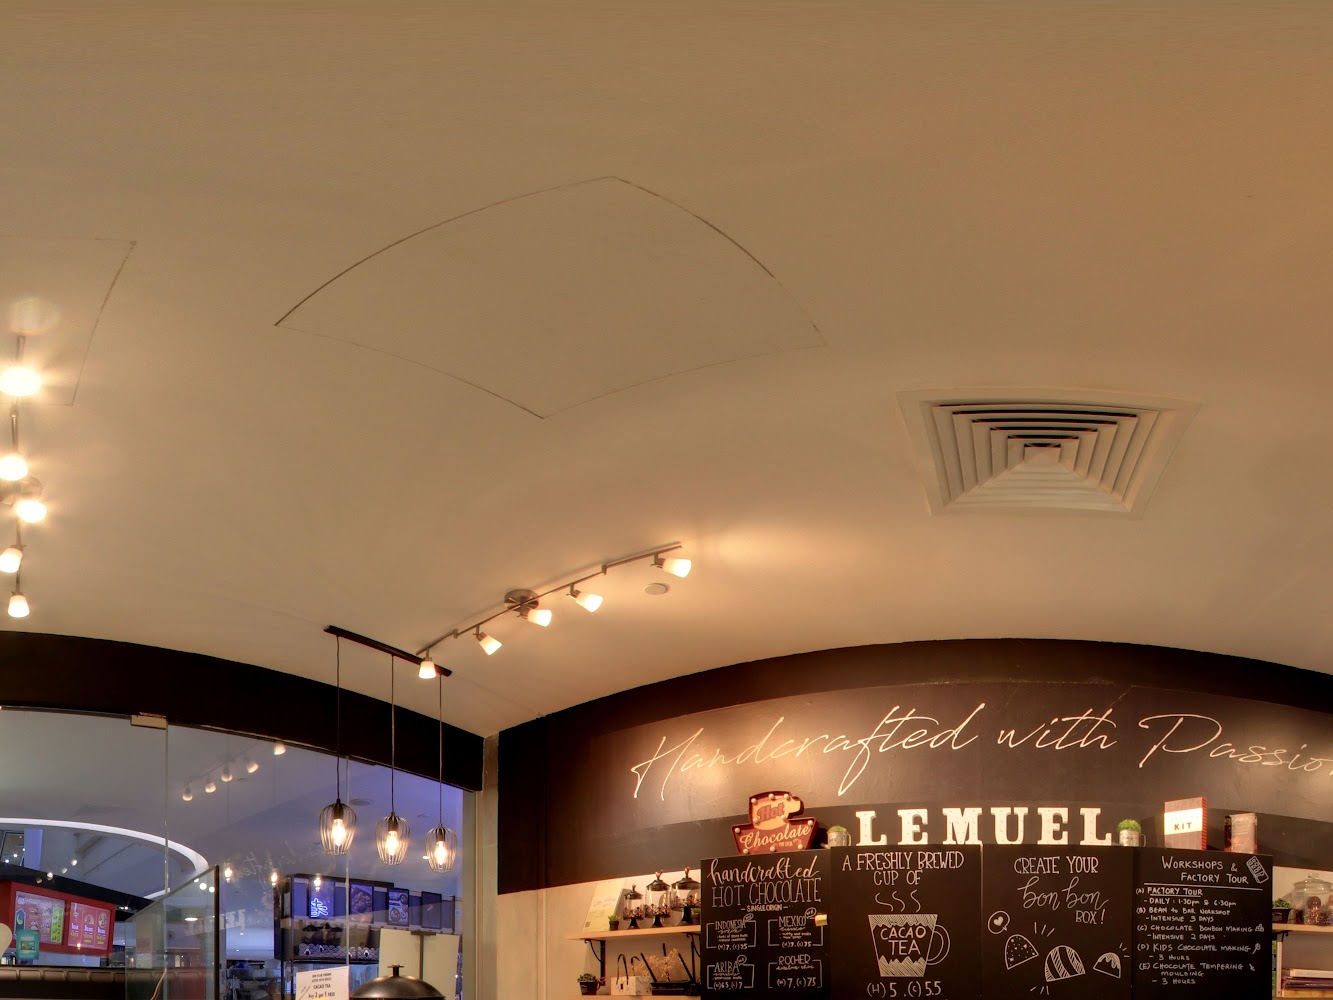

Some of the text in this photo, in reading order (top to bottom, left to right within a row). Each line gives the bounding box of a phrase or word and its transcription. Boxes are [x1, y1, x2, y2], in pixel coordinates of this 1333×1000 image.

[631, 702, 985, 800] Handcrafted
[997, 708, 1117, 750] with
[757, 802, 785, 821] Hot
[855, 807, 1112, 847] LEMUEL
[1174, 822, 1193, 832] KIT
[740, 824, 811, 849] Chocolate
[842, 851, 964, 871] A FRESHLY BREWED
[1013, 856, 1099, 874] CREATE YOUR
[1161, 856, 1238, 872] WORKSHOPS &
[707, 855, 820, 886] handcrafted
[873, 870, 923, 886] CUP OF
[1180, 872, 1249, 884] FACTORY TOUR
[712, 877, 821, 908] HOT CHOCOLATE
[1017, 876, 1109, 910] bon bon
[1147, 887, 1180, 896] FACTORY
[1183, 888, 1203, 896] TOUR
[1149, 897, 1170, 905] DAILY
[1182, 907, 1196, 915] BAR
[1200, 908, 1230, 916] WORKSHOP
[1199, 915, 1214, 923] DAYS
[715, 920, 746, 931] INDONESIA
[779, 915, 807, 928] MEXICO
[880, 926, 927, 941] CACAO
[1199, 933, 1215, 941] DAYS
[888, 940, 921, 955] TEA
[1153, 943, 1173, 952] KIDS
[714, 961, 740, 973] ARIBA
[779, 954, 811, 965] ROCHER
[1153, 963, 1196, 971] CHOCOLATE
[1200, 962, 1244, 970] TEMPERING
[925, 981, 942, 996] 5.5
